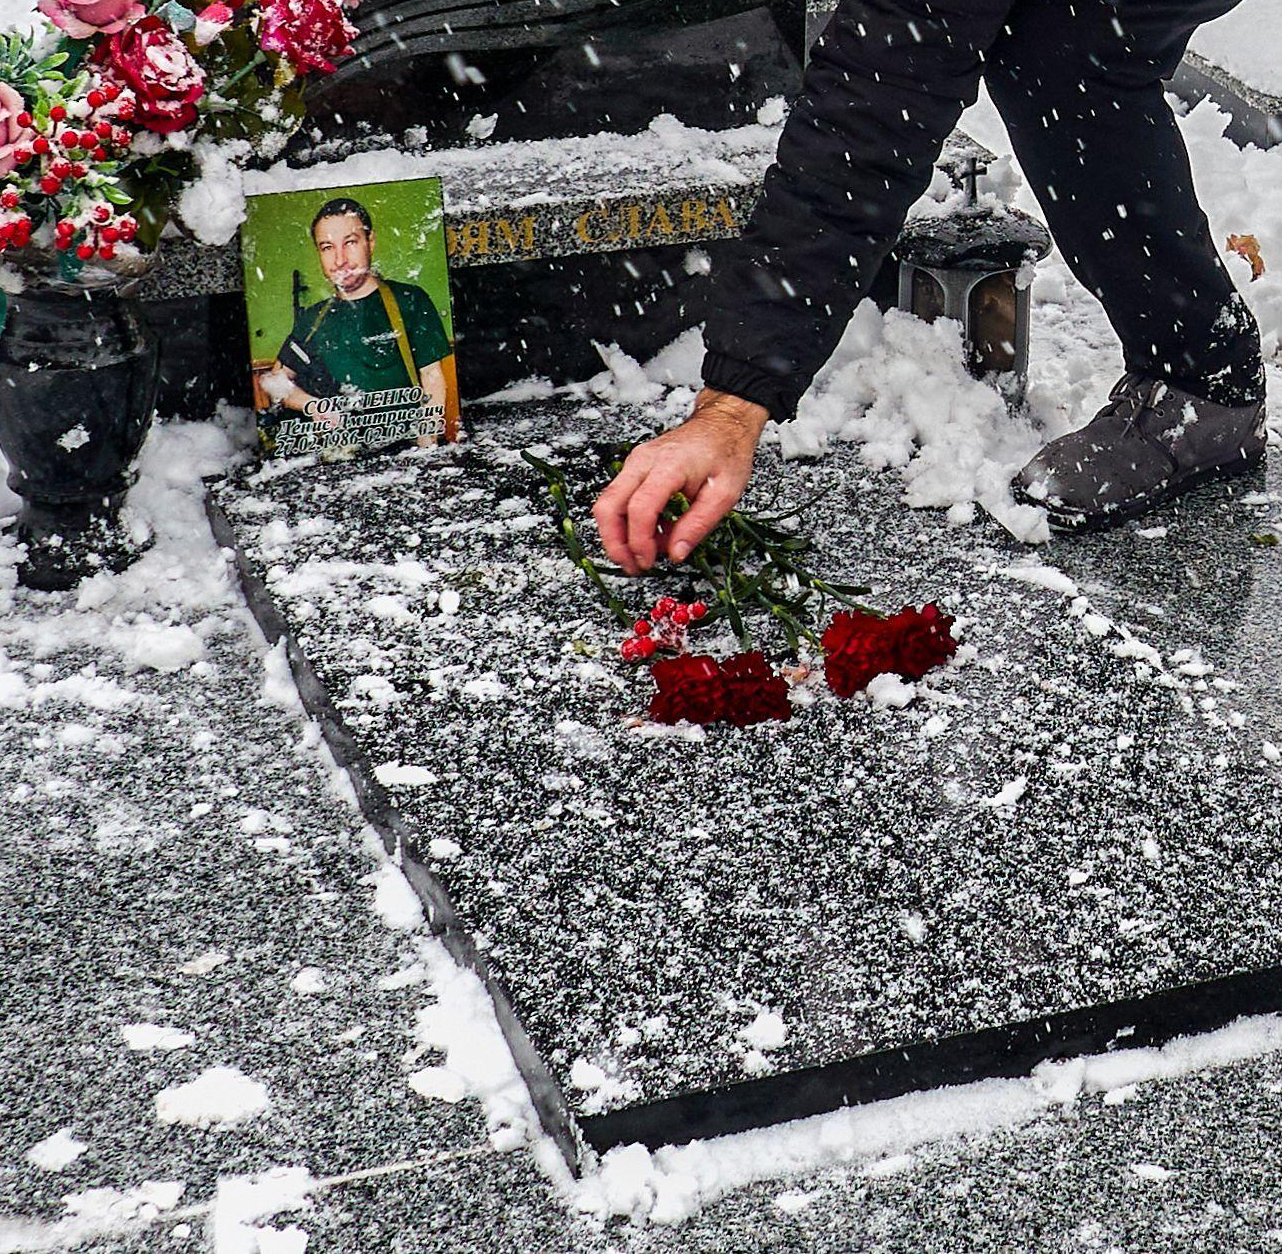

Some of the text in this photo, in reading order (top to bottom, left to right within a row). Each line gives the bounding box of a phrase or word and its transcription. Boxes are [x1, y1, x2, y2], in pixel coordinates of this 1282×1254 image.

[575, 196, 739, 244] СЛАВА
[304, 386, 423, 416] СОКЛЕНКО
[274, 418, 446, 457] 27.02.1986-02.03.022
